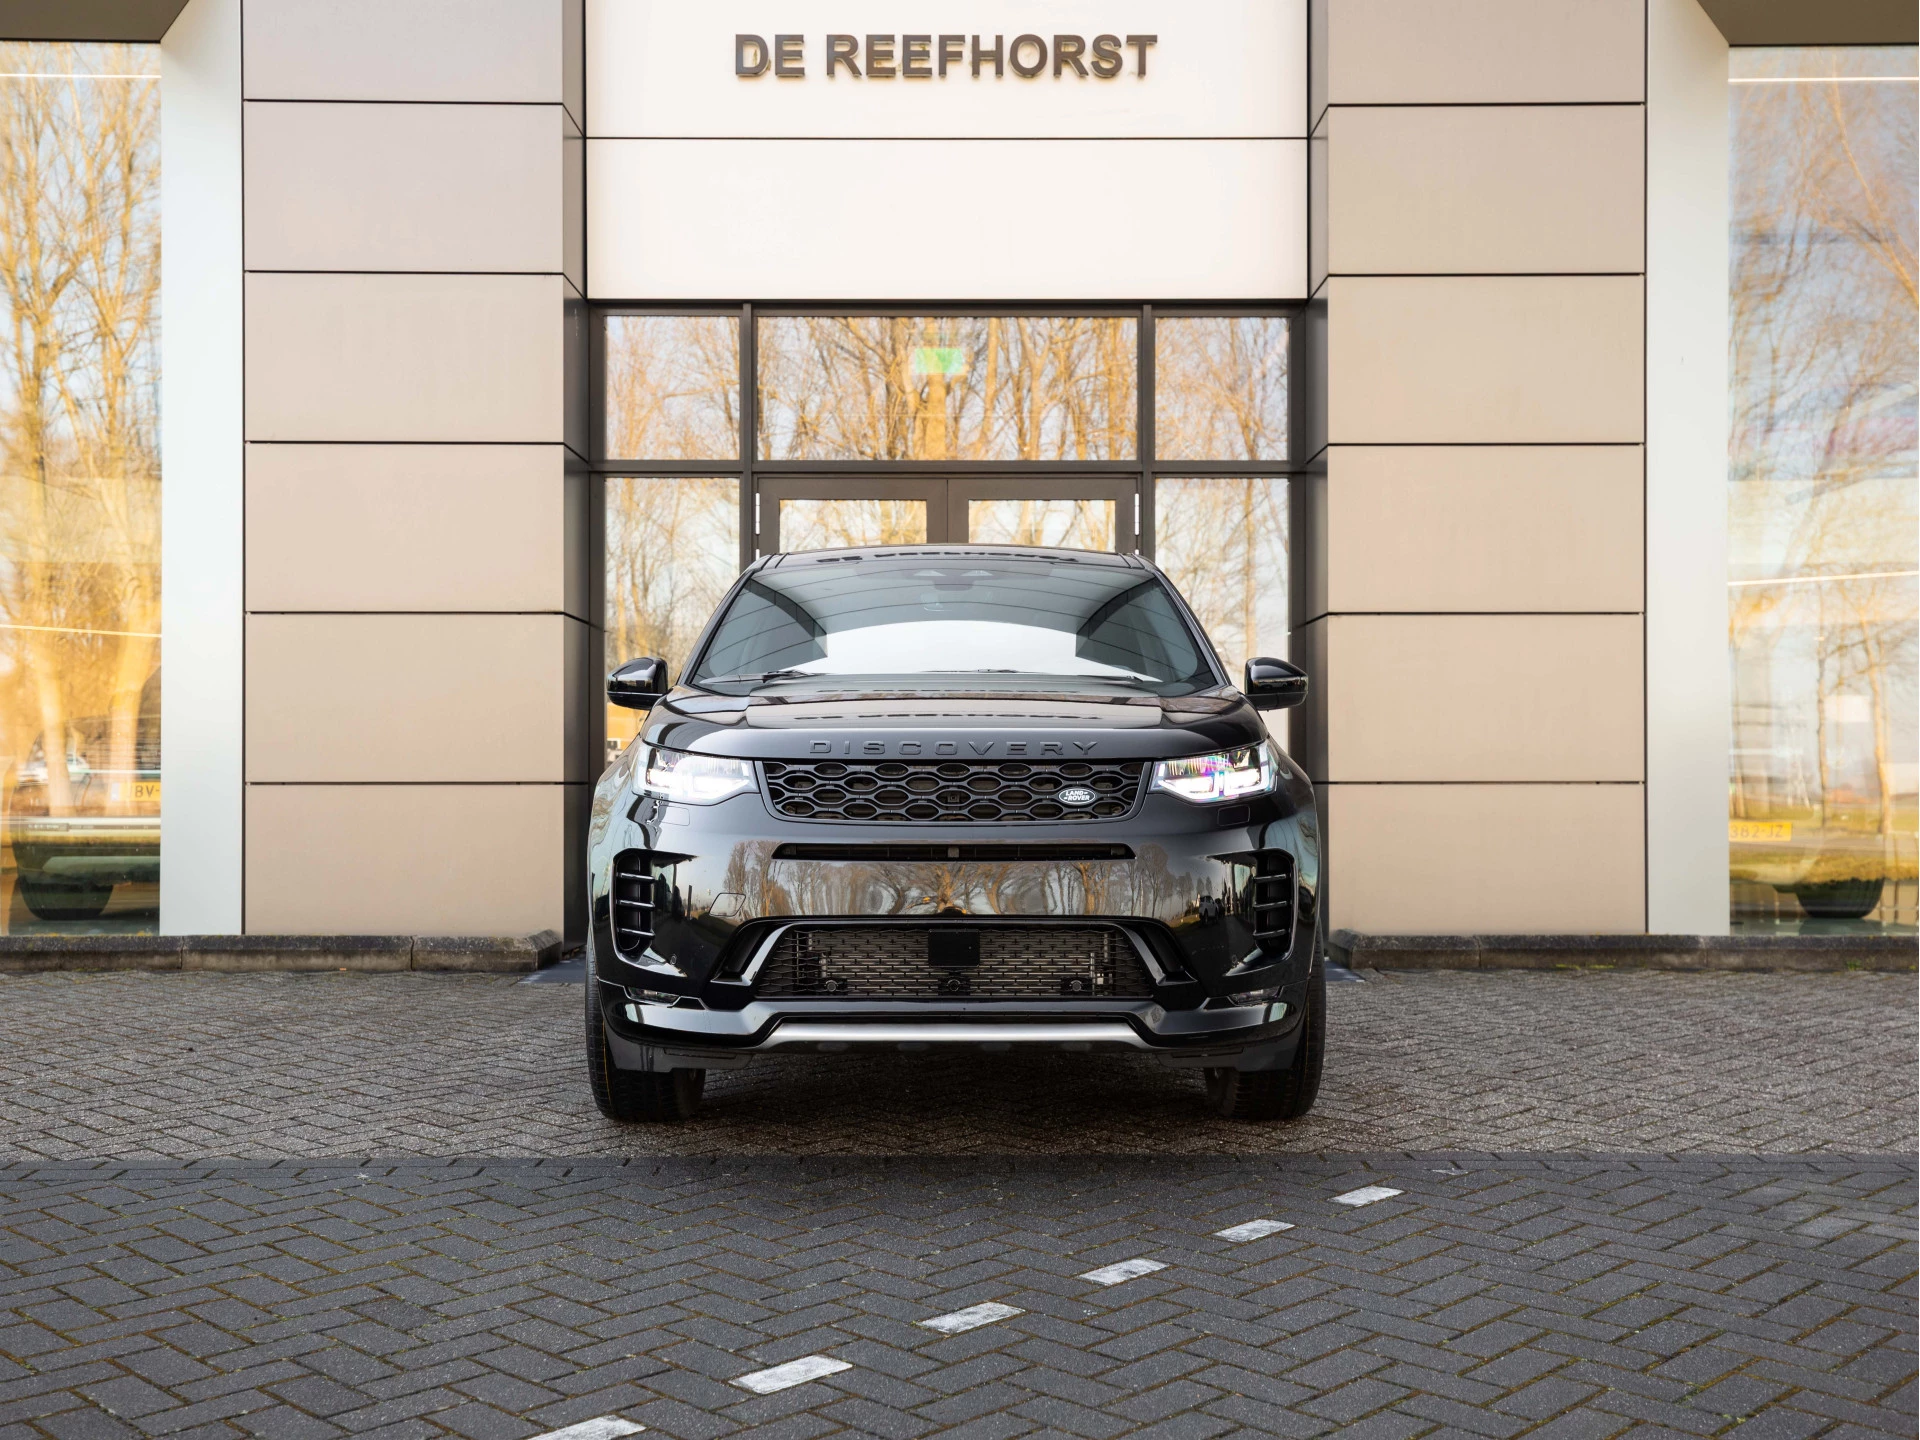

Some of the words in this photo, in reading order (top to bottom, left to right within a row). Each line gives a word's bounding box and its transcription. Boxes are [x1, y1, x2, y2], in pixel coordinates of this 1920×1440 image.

[735, 34, 805, 77] DE
[826, 34, 1158, 78] REEFHORST
[809, 740, 1098, 756] DISCOVERY
